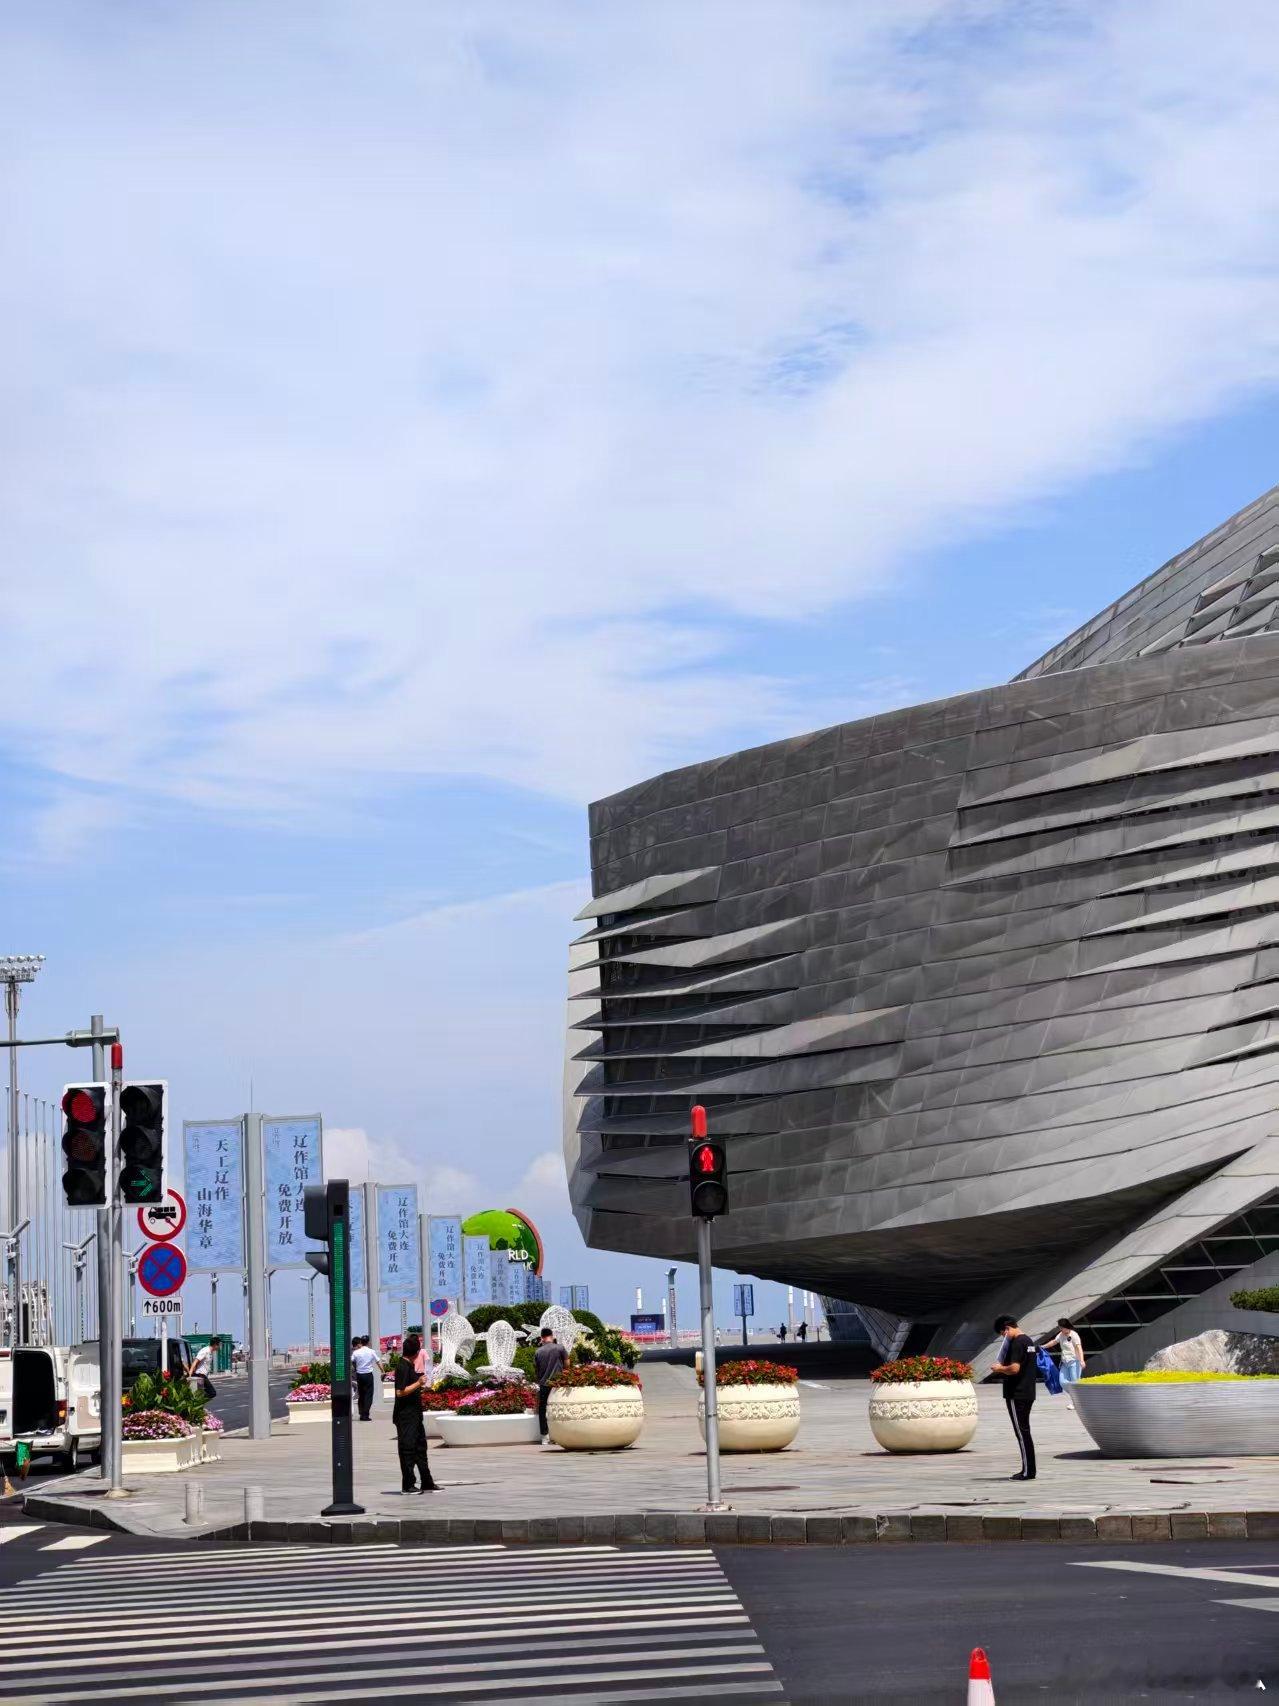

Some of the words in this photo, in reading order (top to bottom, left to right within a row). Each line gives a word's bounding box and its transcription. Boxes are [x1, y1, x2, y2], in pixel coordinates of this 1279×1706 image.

[215, 1138, 230, 1201] 天工辽作
[197, 1187, 213, 1249] 山海华章
[278, 1183, 293, 1246] 免费开放
[152, 1300, 181, 1313] 600m
